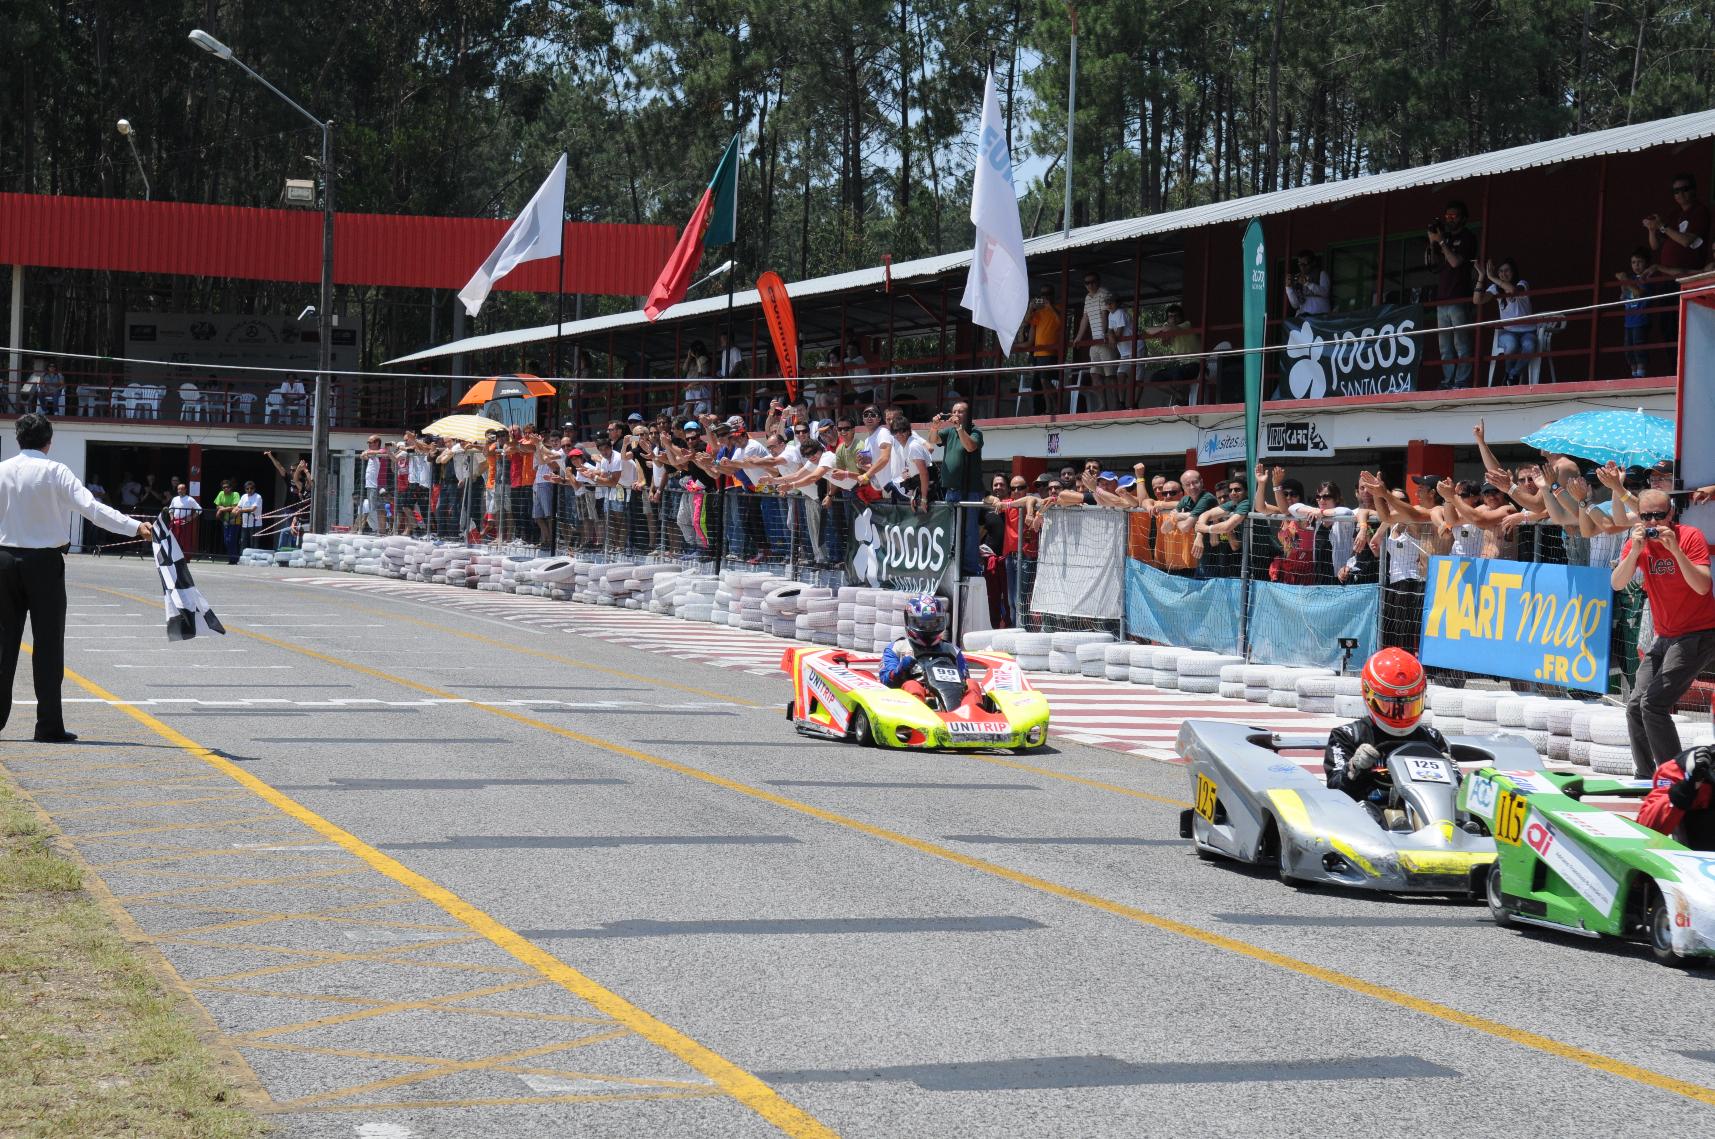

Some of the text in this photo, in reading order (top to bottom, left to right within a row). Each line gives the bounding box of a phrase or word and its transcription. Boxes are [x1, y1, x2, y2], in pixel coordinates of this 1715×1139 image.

[1331, 320, 1415, 391] JOGOS
[1340, 372, 1411, 397] SANTACASA
[1268, 425, 1285, 448] VIRUS
[882, 525, 945, 581] JOGOS
[1648, 555, 1675, 575] Lee
[1425, 560, 1607, 683] KART mag
[937, 668, 956, 676] 99
[1534, 653, 1569, 683] .FR
[808, 669, 836, 704] UNITRIP
[950, 722, 1007, 732] UNITRIP
[1413, 760, 1440, 770] 125
[1197, 777, 1216, 820] 125
[1497, 796, 1524, 843] 115
